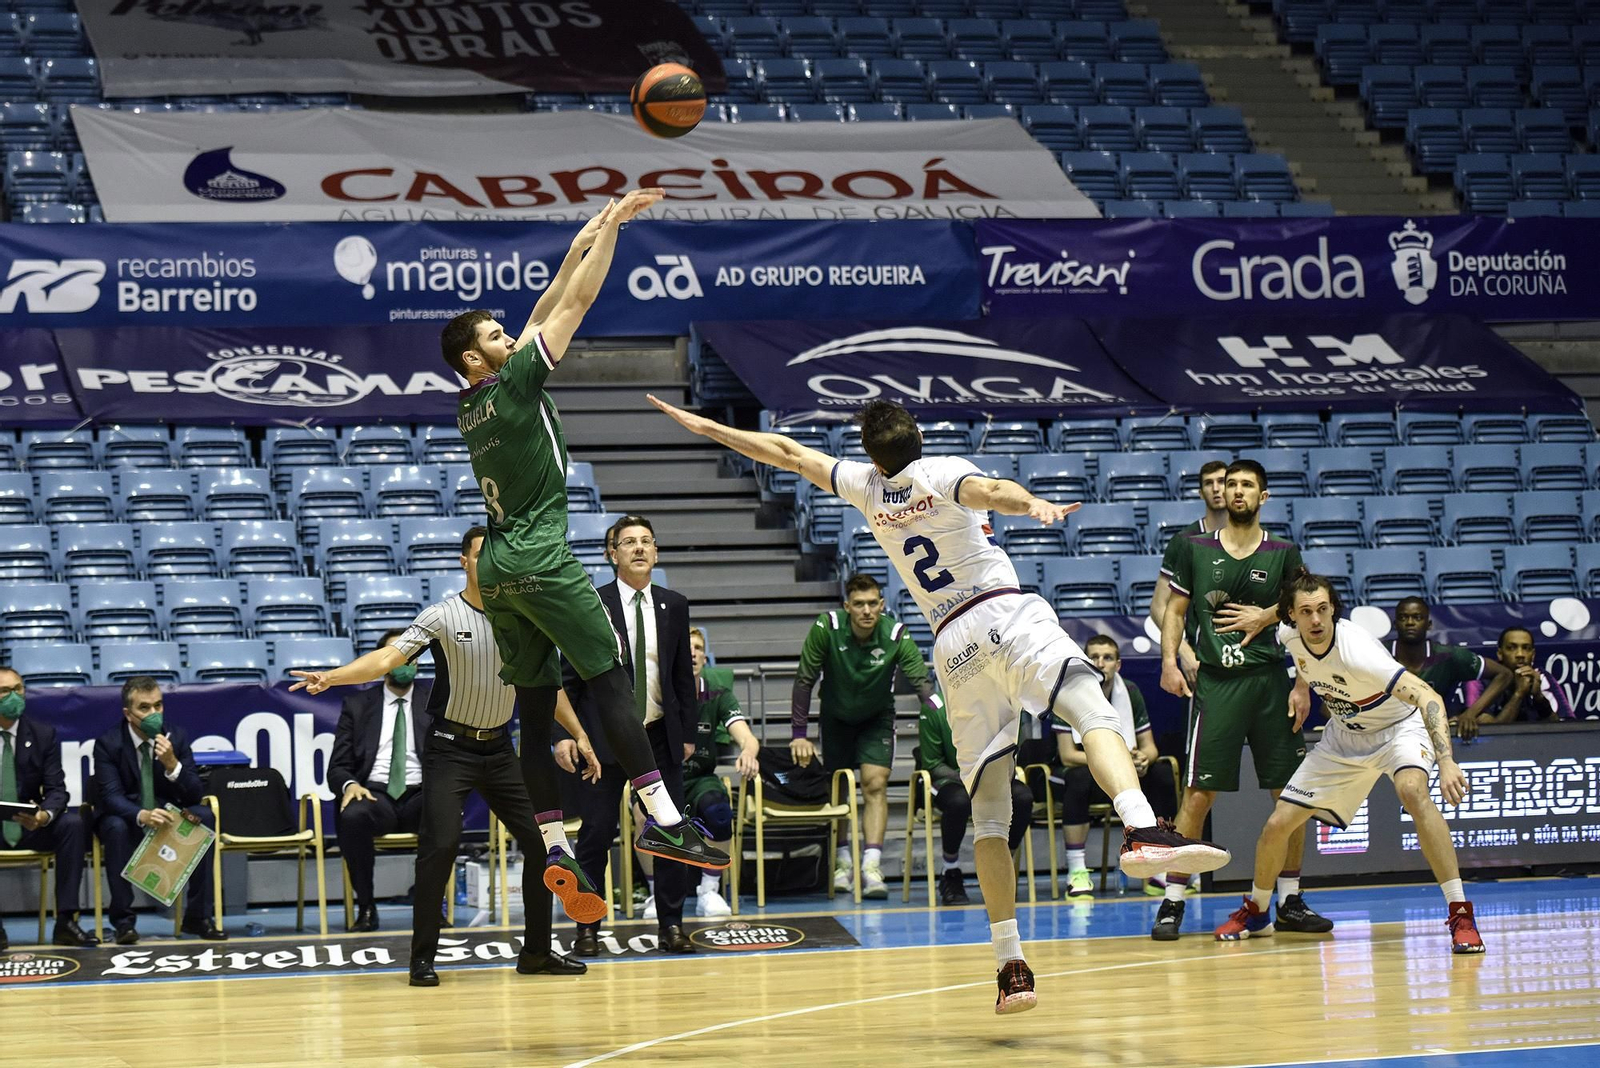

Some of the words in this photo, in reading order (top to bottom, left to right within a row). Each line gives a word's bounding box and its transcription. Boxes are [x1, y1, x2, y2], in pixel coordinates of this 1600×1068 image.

[874, 205, 1014, 219] GALICIA
[118, 252, 256, 278] recambios
[420, 246, 478, 261] pinturas
[1448, 250, 1567, 276] Deputación
[387, 252, 549, 300] magide
[715, 267, 742, 288] AD
[750, 266, 823, 287] GRUPO
[829, 265, 926, 287] REGUEIRA
[1192, 236, 1365, 300] Grada
[118, 281, 257, 312] Barreiro
[1449, 277, 1479, 297] DA
[1484, 273, 1568, 296] CORUÑA
[207, 345, 343, 363] CONSERVAS
[77, 365, 467, 397] PESCAMA
[807, 374, 1117, 401] OVIGA
[1185, 369, 1262, 386] hm
[1268, 364, 1489, 386] hospitales
[1241, 387, 1344, 397] Somos
[1351, 386, 1383, 394] tu
[457, 400, 497, 433] RIZUELA
[903, 535, 955, 594] 2
[1221, 643, 1245, 668] 83
[705, 928, 787, 939] Estrella
[712, 935, 789, 946] Galicia
[101, 944, 396, 977] Estrella
